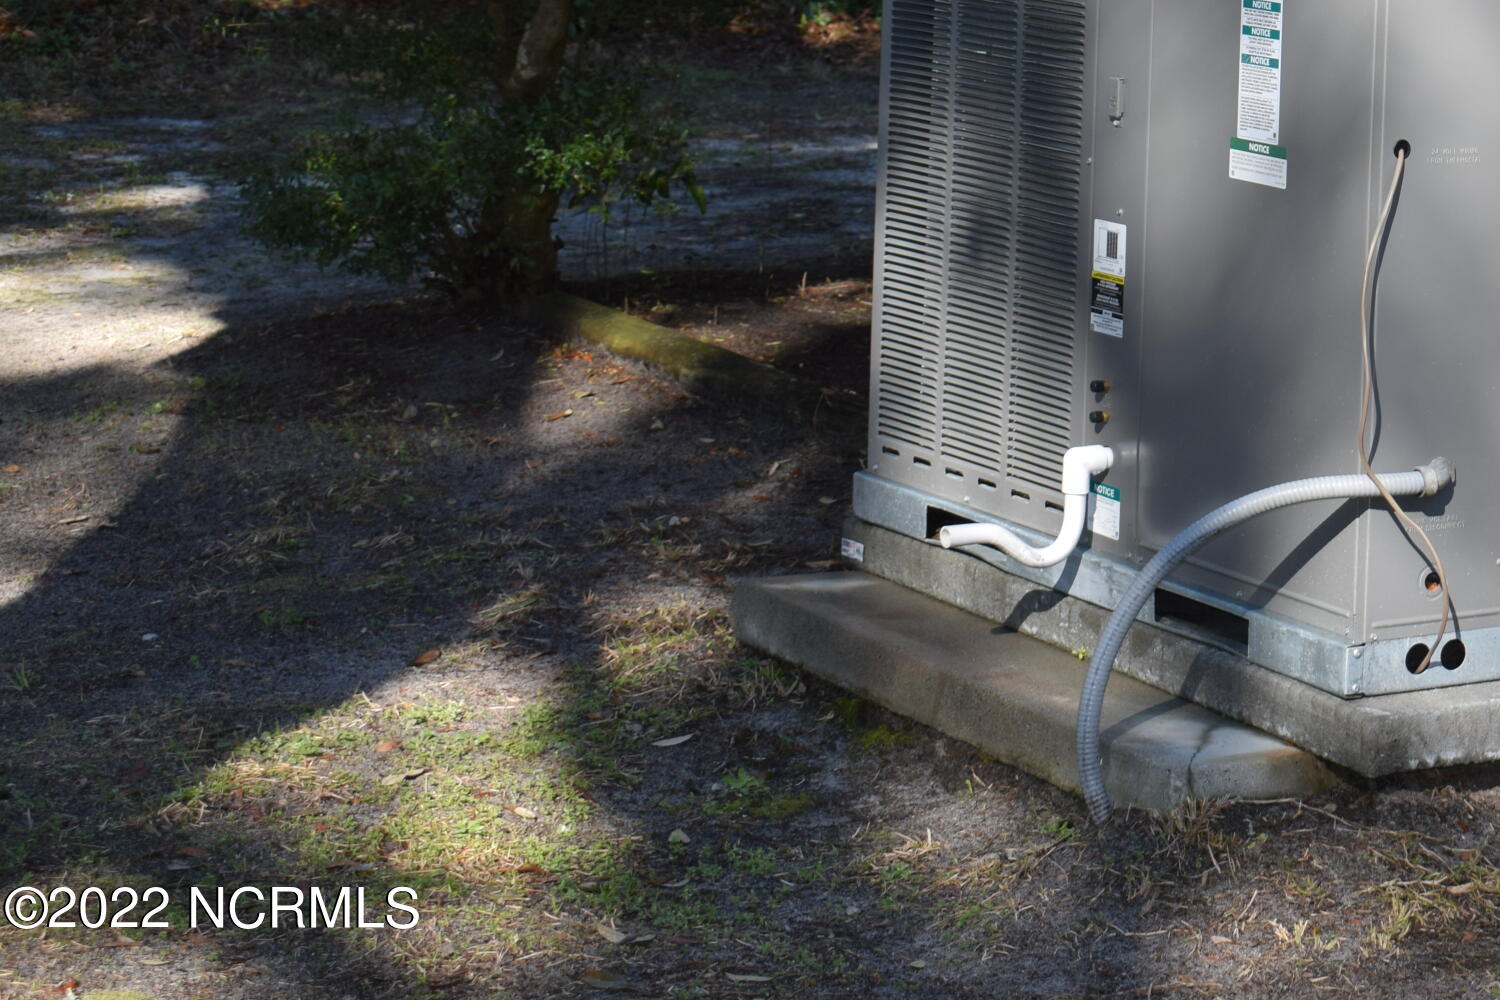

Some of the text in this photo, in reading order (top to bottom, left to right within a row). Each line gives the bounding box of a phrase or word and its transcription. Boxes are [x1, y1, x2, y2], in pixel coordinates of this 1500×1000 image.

[1252, 0, 1272, 10] NOTICE
[1251, 27, 1271, 37] NOTICE
[1250, 56, 1270, 66] NOTICE
[1248, 142, 1270, 154] NOTICE
[1094, 483, 1115, 498] NOTICE
